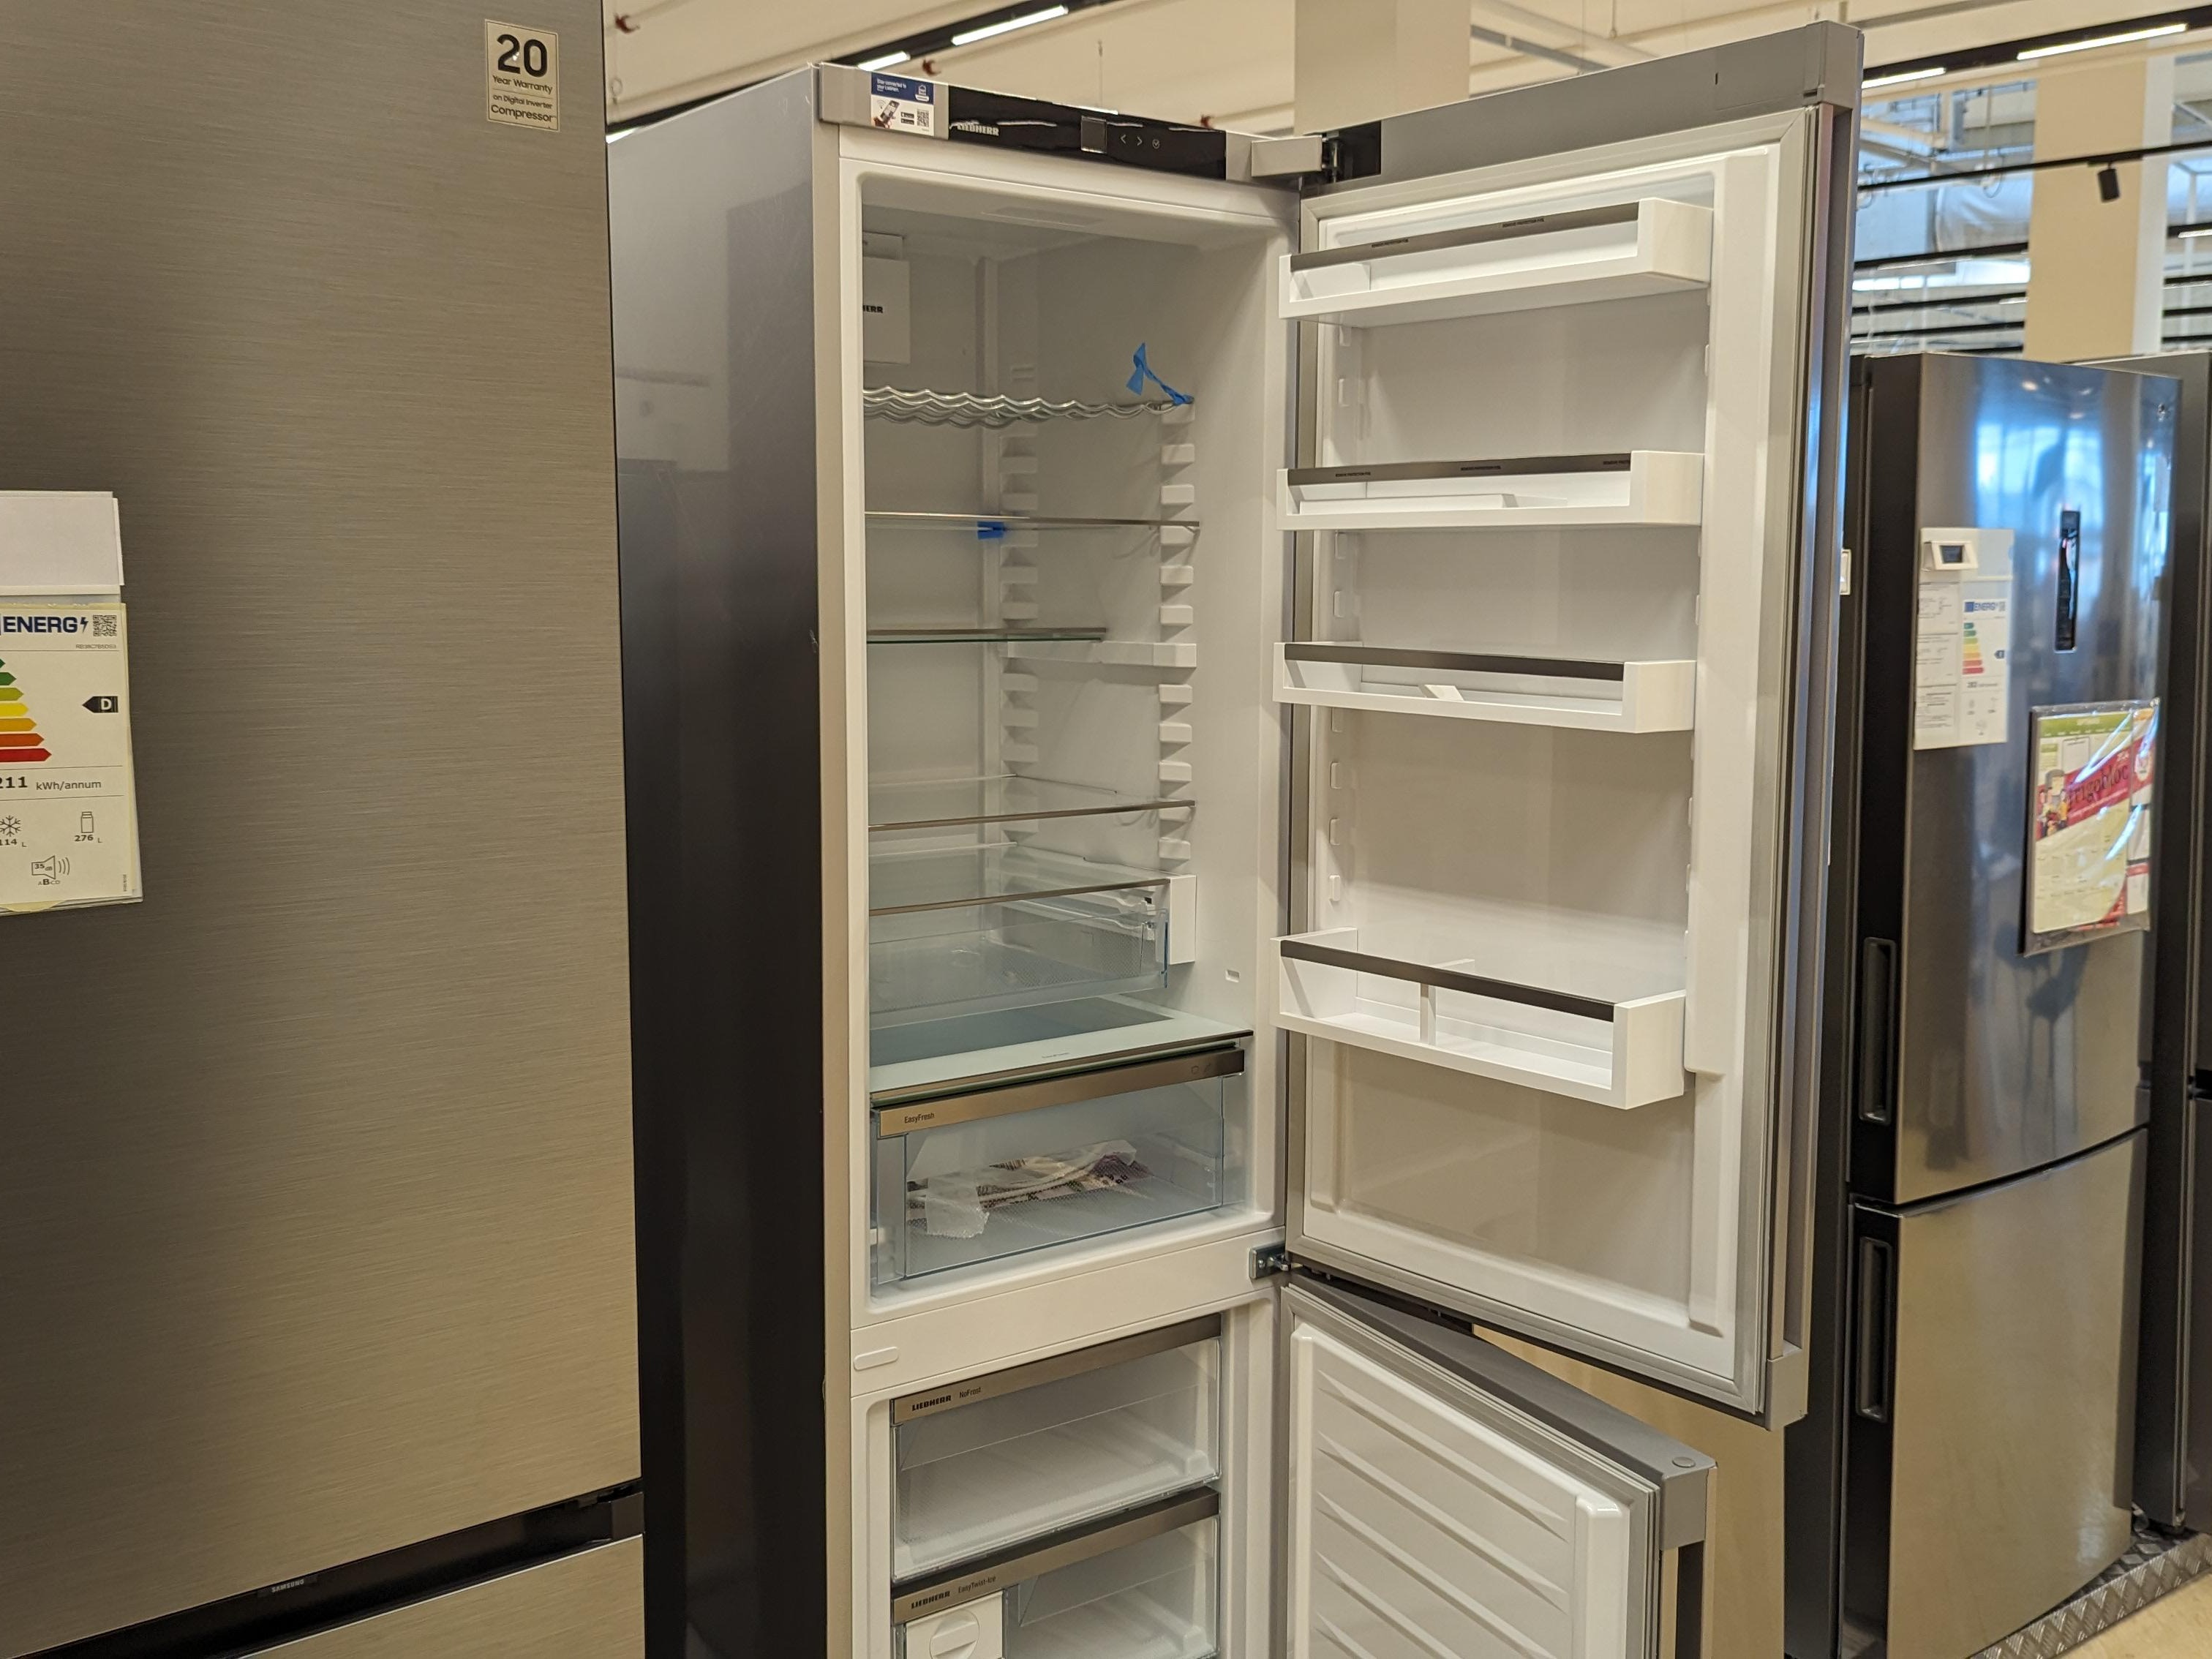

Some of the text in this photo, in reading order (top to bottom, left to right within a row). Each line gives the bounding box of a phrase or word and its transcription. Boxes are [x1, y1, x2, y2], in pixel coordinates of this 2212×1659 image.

[497, 34, 547, 78] 20
[492, 75, 553, 95] Year Warranty
[504, 95, 525, 105] Digital
[526, 99, 553, 109] Inverter
[491, 105, 554, 123] Compressor
[3, 616, 78, 633] ENERG
[100, 699, 112, 710] D
[36, 780, 102, 791] kWh/annum
[904, 1113, 935, 1124] EasyFresh
[911, 1386, 982, 1412] LIEBHERR NoFrost
[271, 1579, 305, 1593] SAMSUNG
